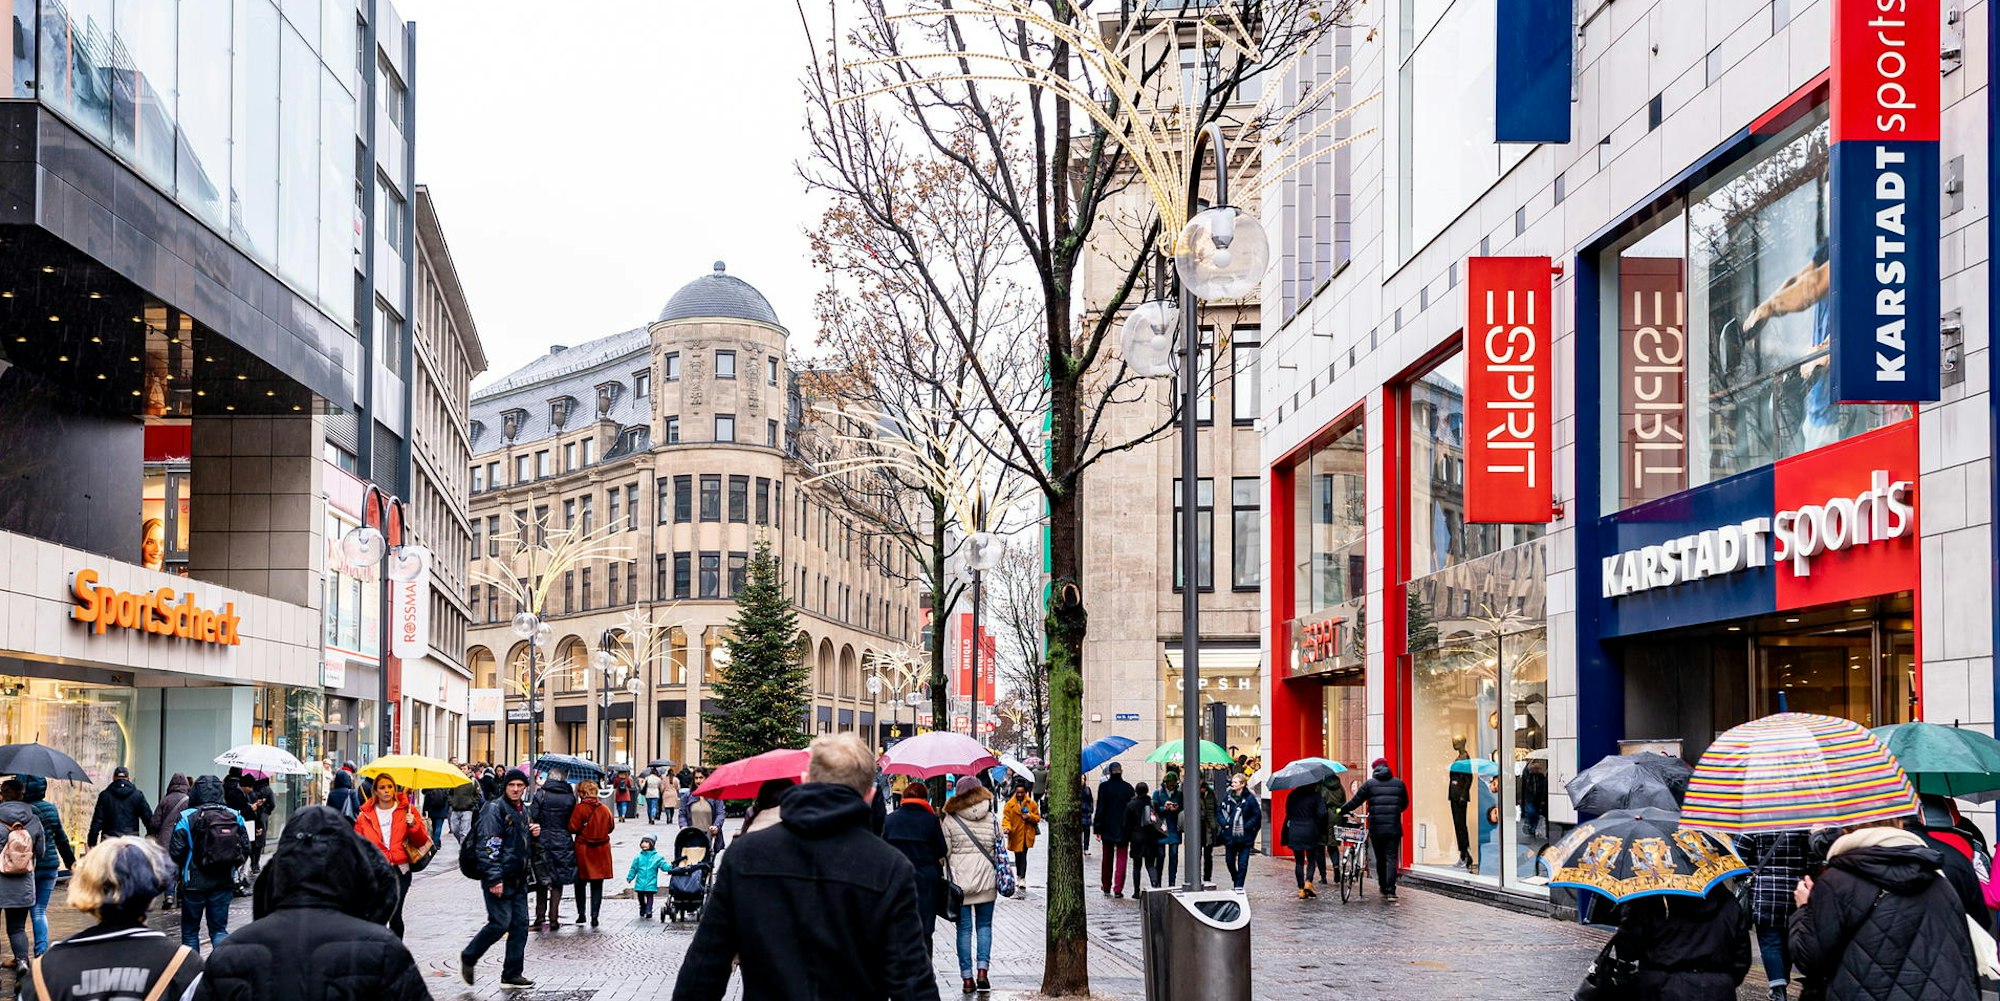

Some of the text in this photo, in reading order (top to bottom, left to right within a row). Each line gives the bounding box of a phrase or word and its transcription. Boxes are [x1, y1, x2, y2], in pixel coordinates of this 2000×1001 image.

[1868, 0, 1916, 381] KARSTADT sports
[1485, 290, 1536, 488] ESPRIT
[1602, 469, 1914, 598] KARSTADT sports
[74, 568, 241, 646] SportScheck
[403, 581, 416, 643] ROSSMA
[963, 639, 971, 670] UNIQLO
[1167, 704, 1261, 717] TMA
[72, 967, 150, 996] JIMIN
